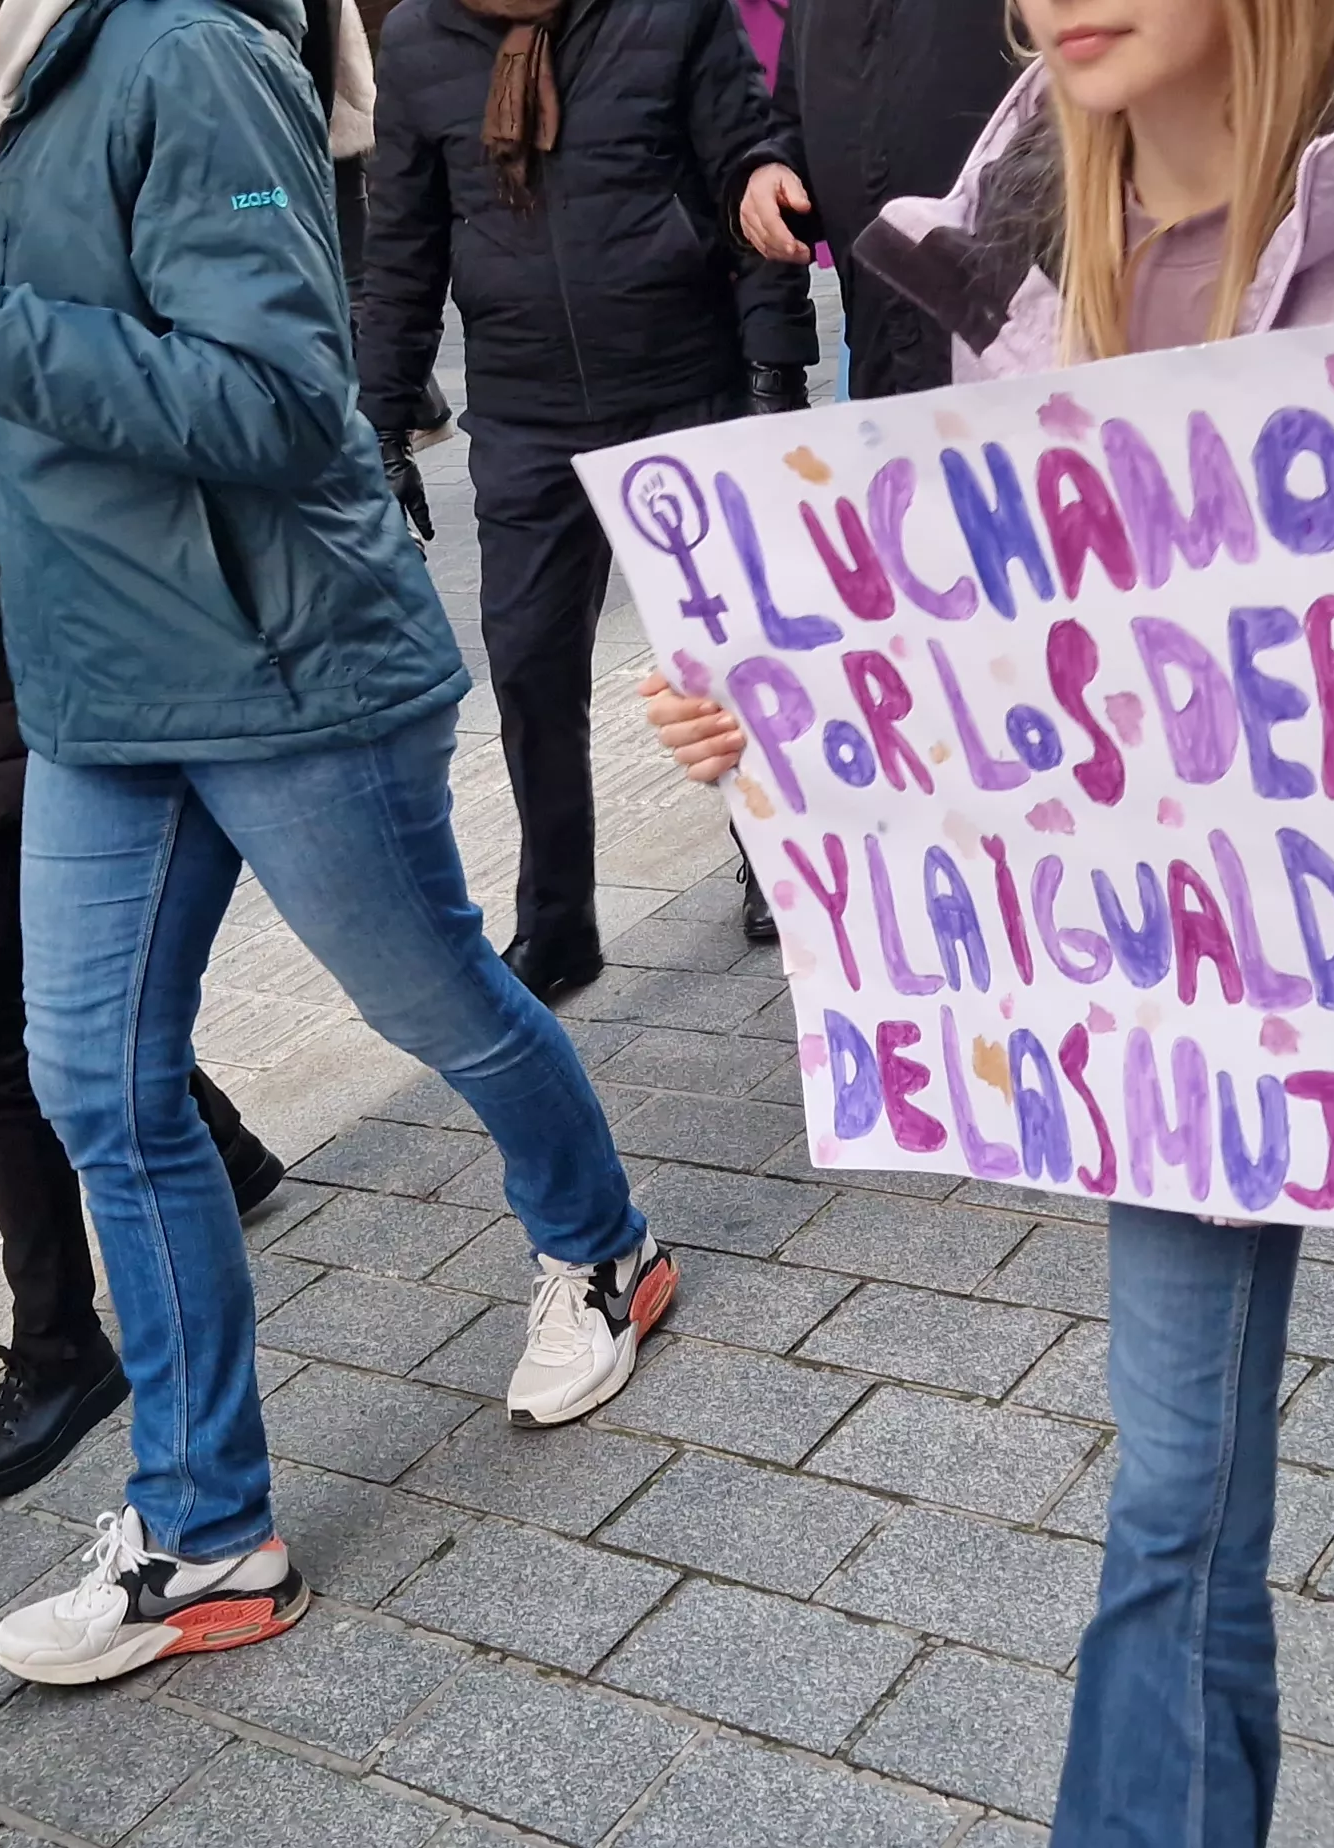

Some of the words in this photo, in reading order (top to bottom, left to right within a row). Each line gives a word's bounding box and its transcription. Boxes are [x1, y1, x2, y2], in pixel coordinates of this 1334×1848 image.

[726, 656, 935, 815] POR
[928, 618, 1125, 806] LOS
[824, 1008, 948, 1152] DE
[941, 1004, 1117, 1196] LAS
